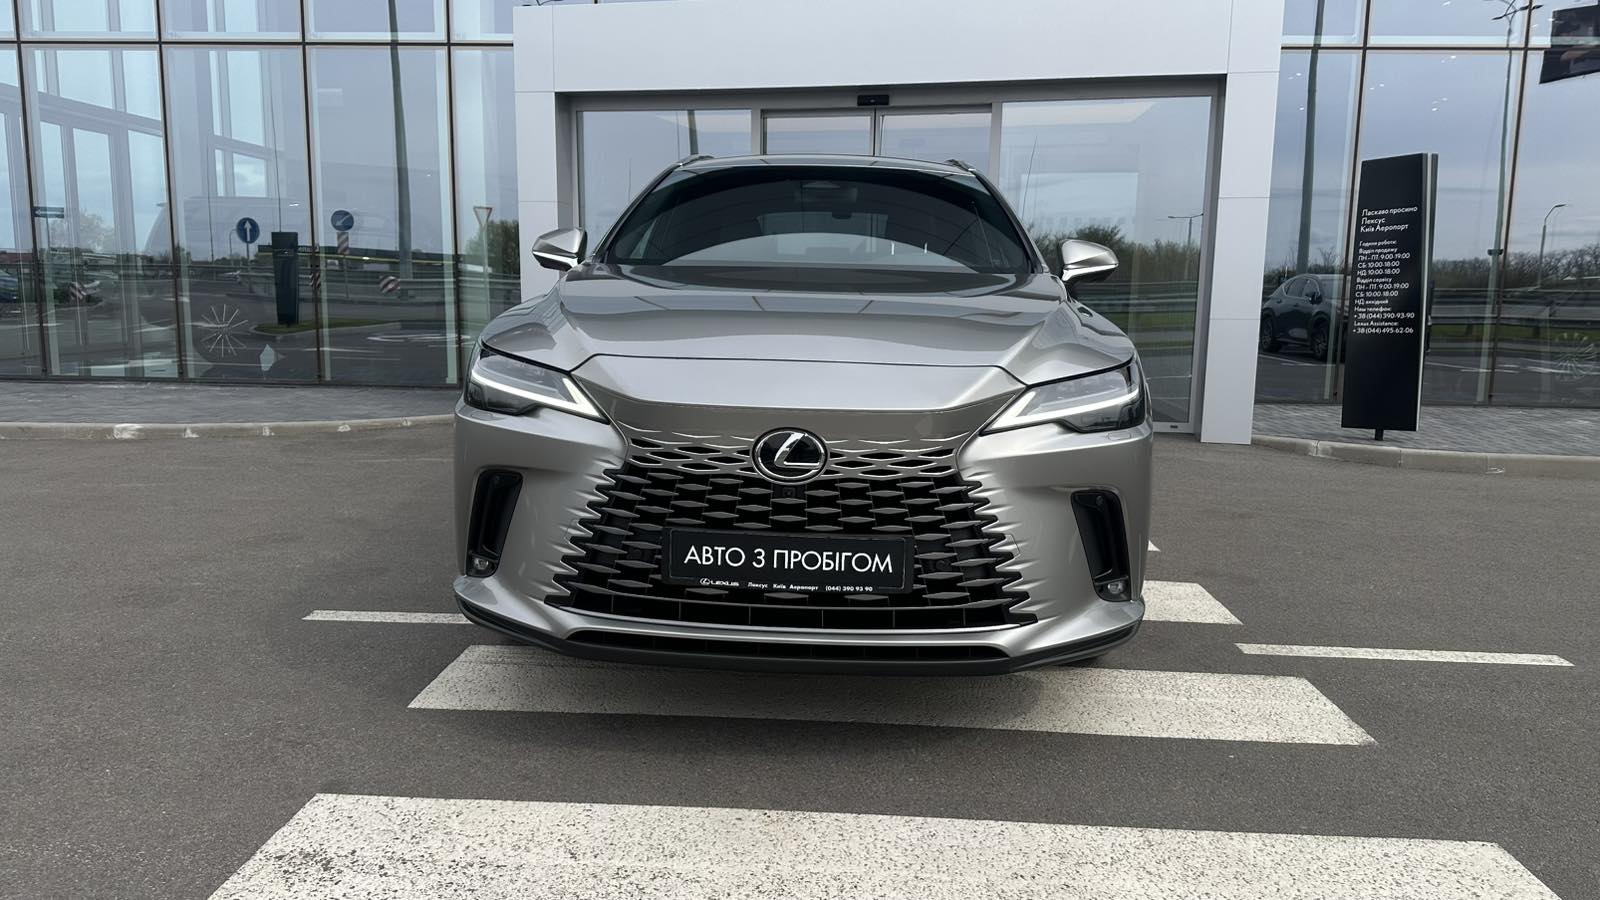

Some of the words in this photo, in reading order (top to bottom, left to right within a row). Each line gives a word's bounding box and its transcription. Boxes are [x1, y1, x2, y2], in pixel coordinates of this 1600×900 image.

[1362, 208, 1388, 216] Ласкаво
[1390, 206, 1418, 214] просимо
[1376, 224, 1408, 232] Аеропорт
[684, 545, 746, 567] АВТО
[773, 550, 893, 574] ПРОБІГОМ
